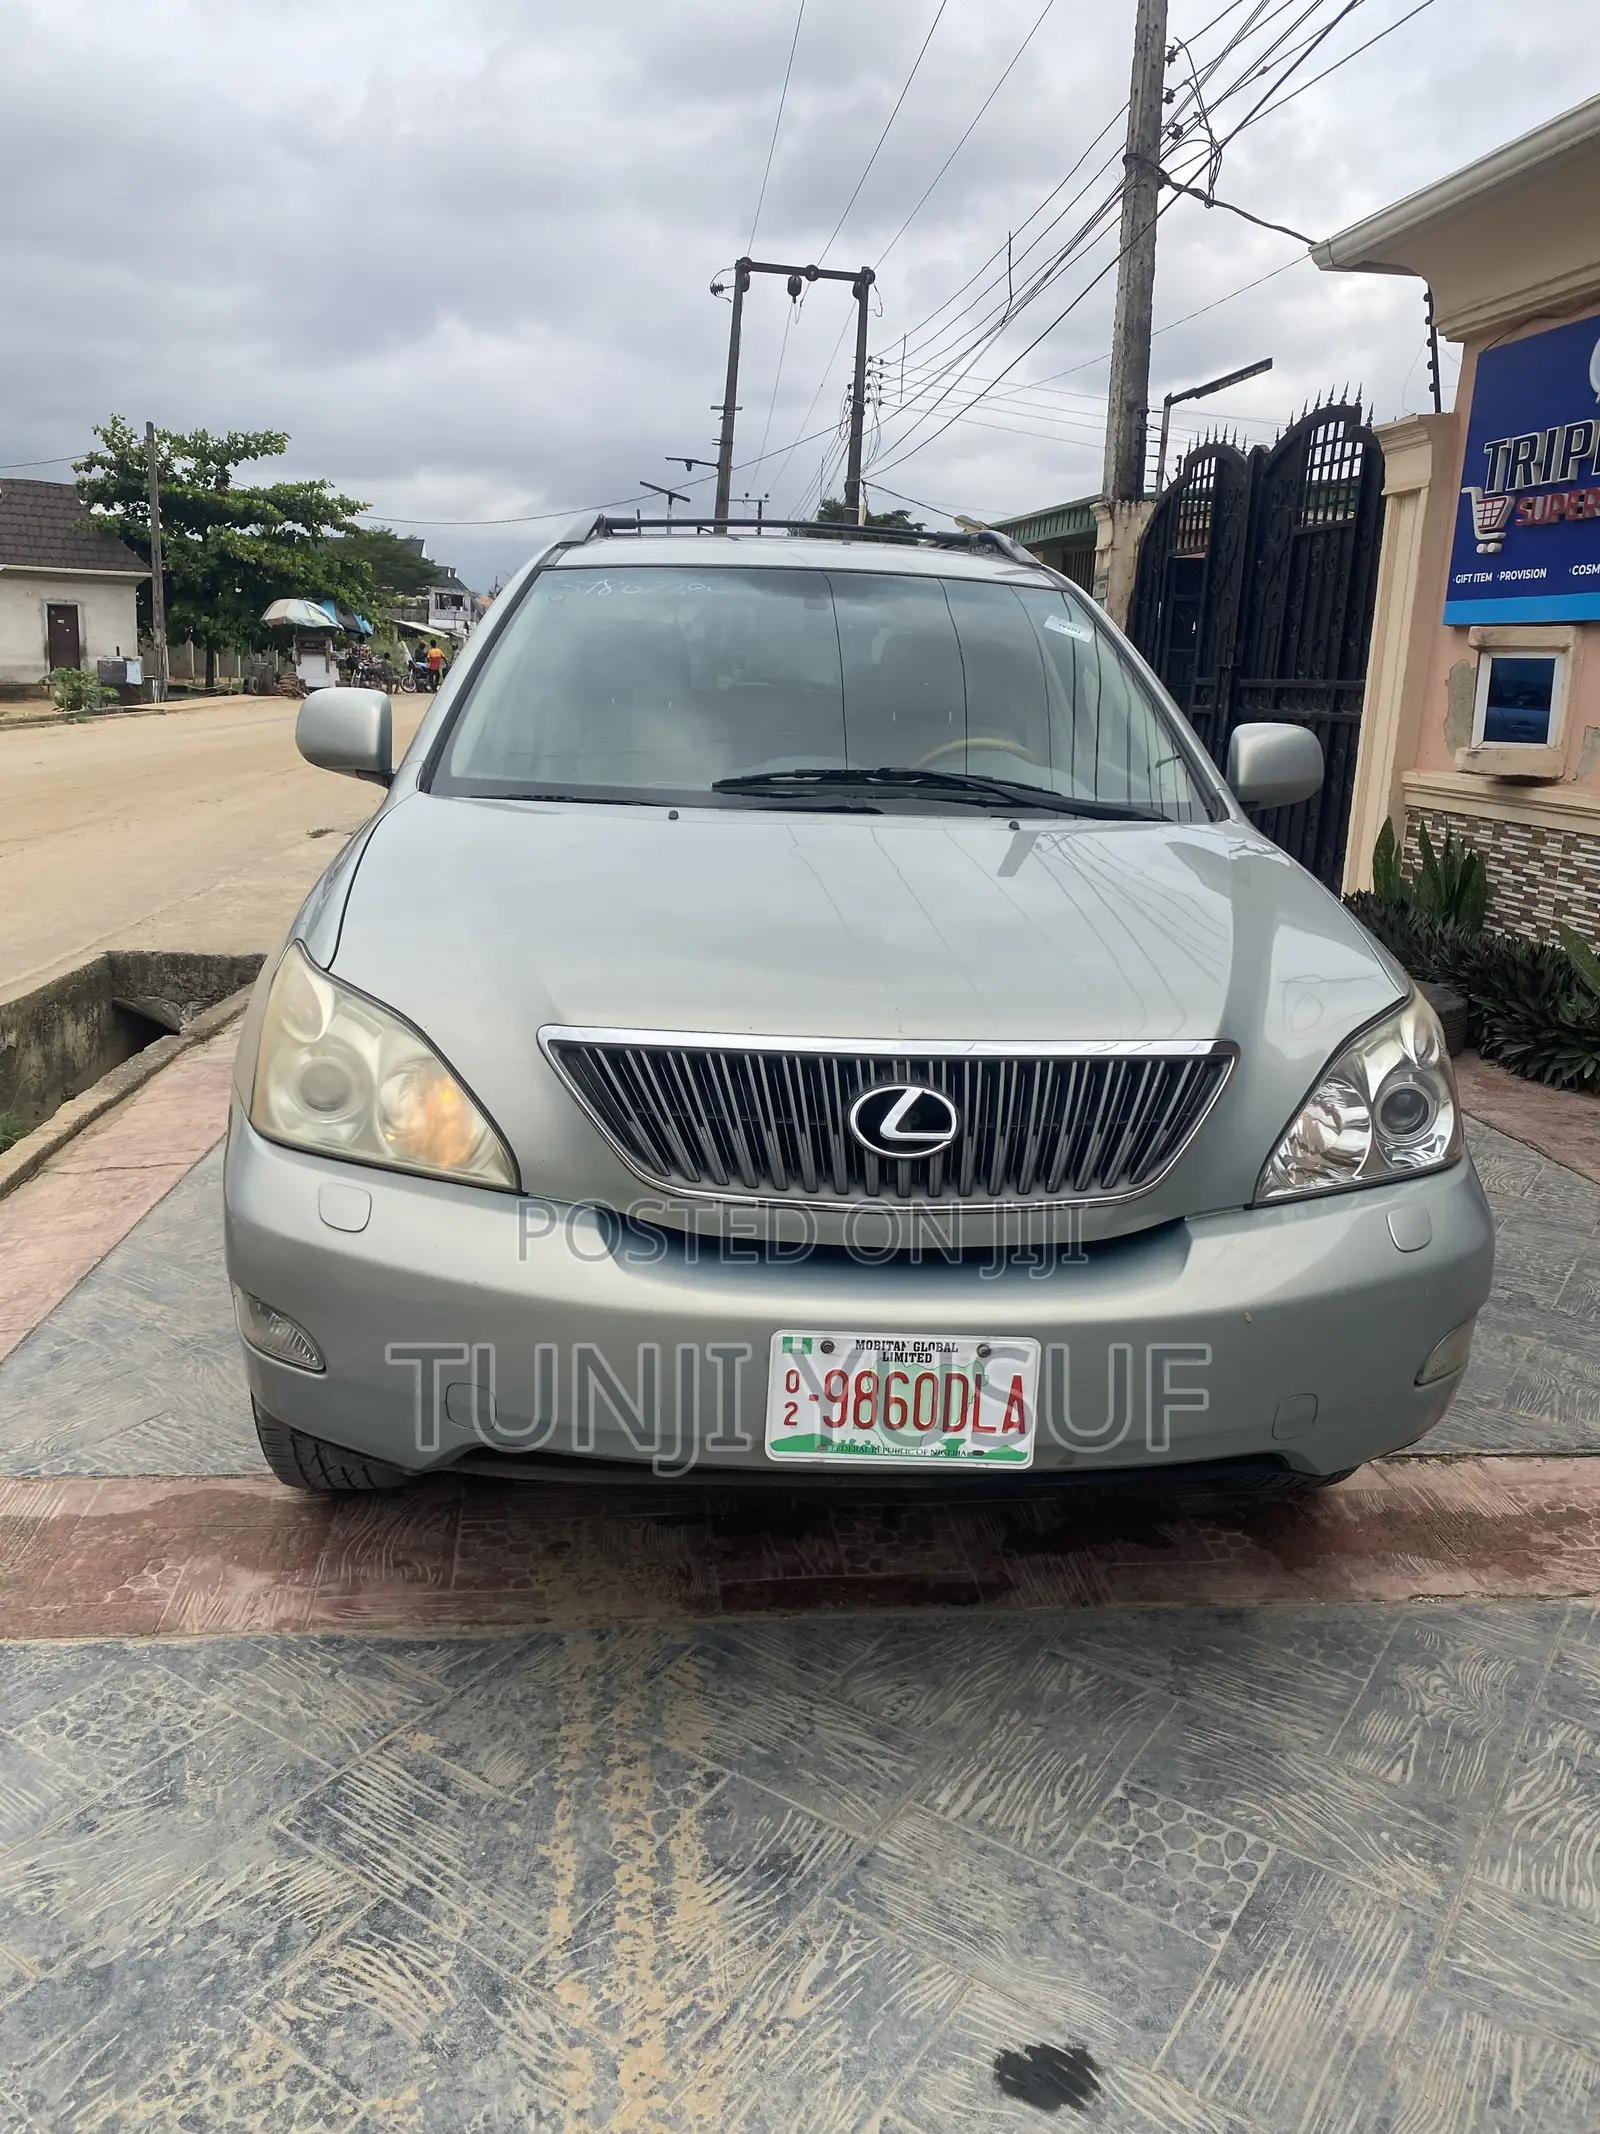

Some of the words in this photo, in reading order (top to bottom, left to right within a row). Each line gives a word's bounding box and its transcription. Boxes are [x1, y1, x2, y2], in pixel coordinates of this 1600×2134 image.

[1455, 573, 1473, 583] GIFT
[1473, 572, 1492, 582] ITEM
[1500, 568, 1547, 580] PROVISION
[913, 1342, 958, 1353] GLOBAL
[882, 1352, 932, 1363] LIMITED
